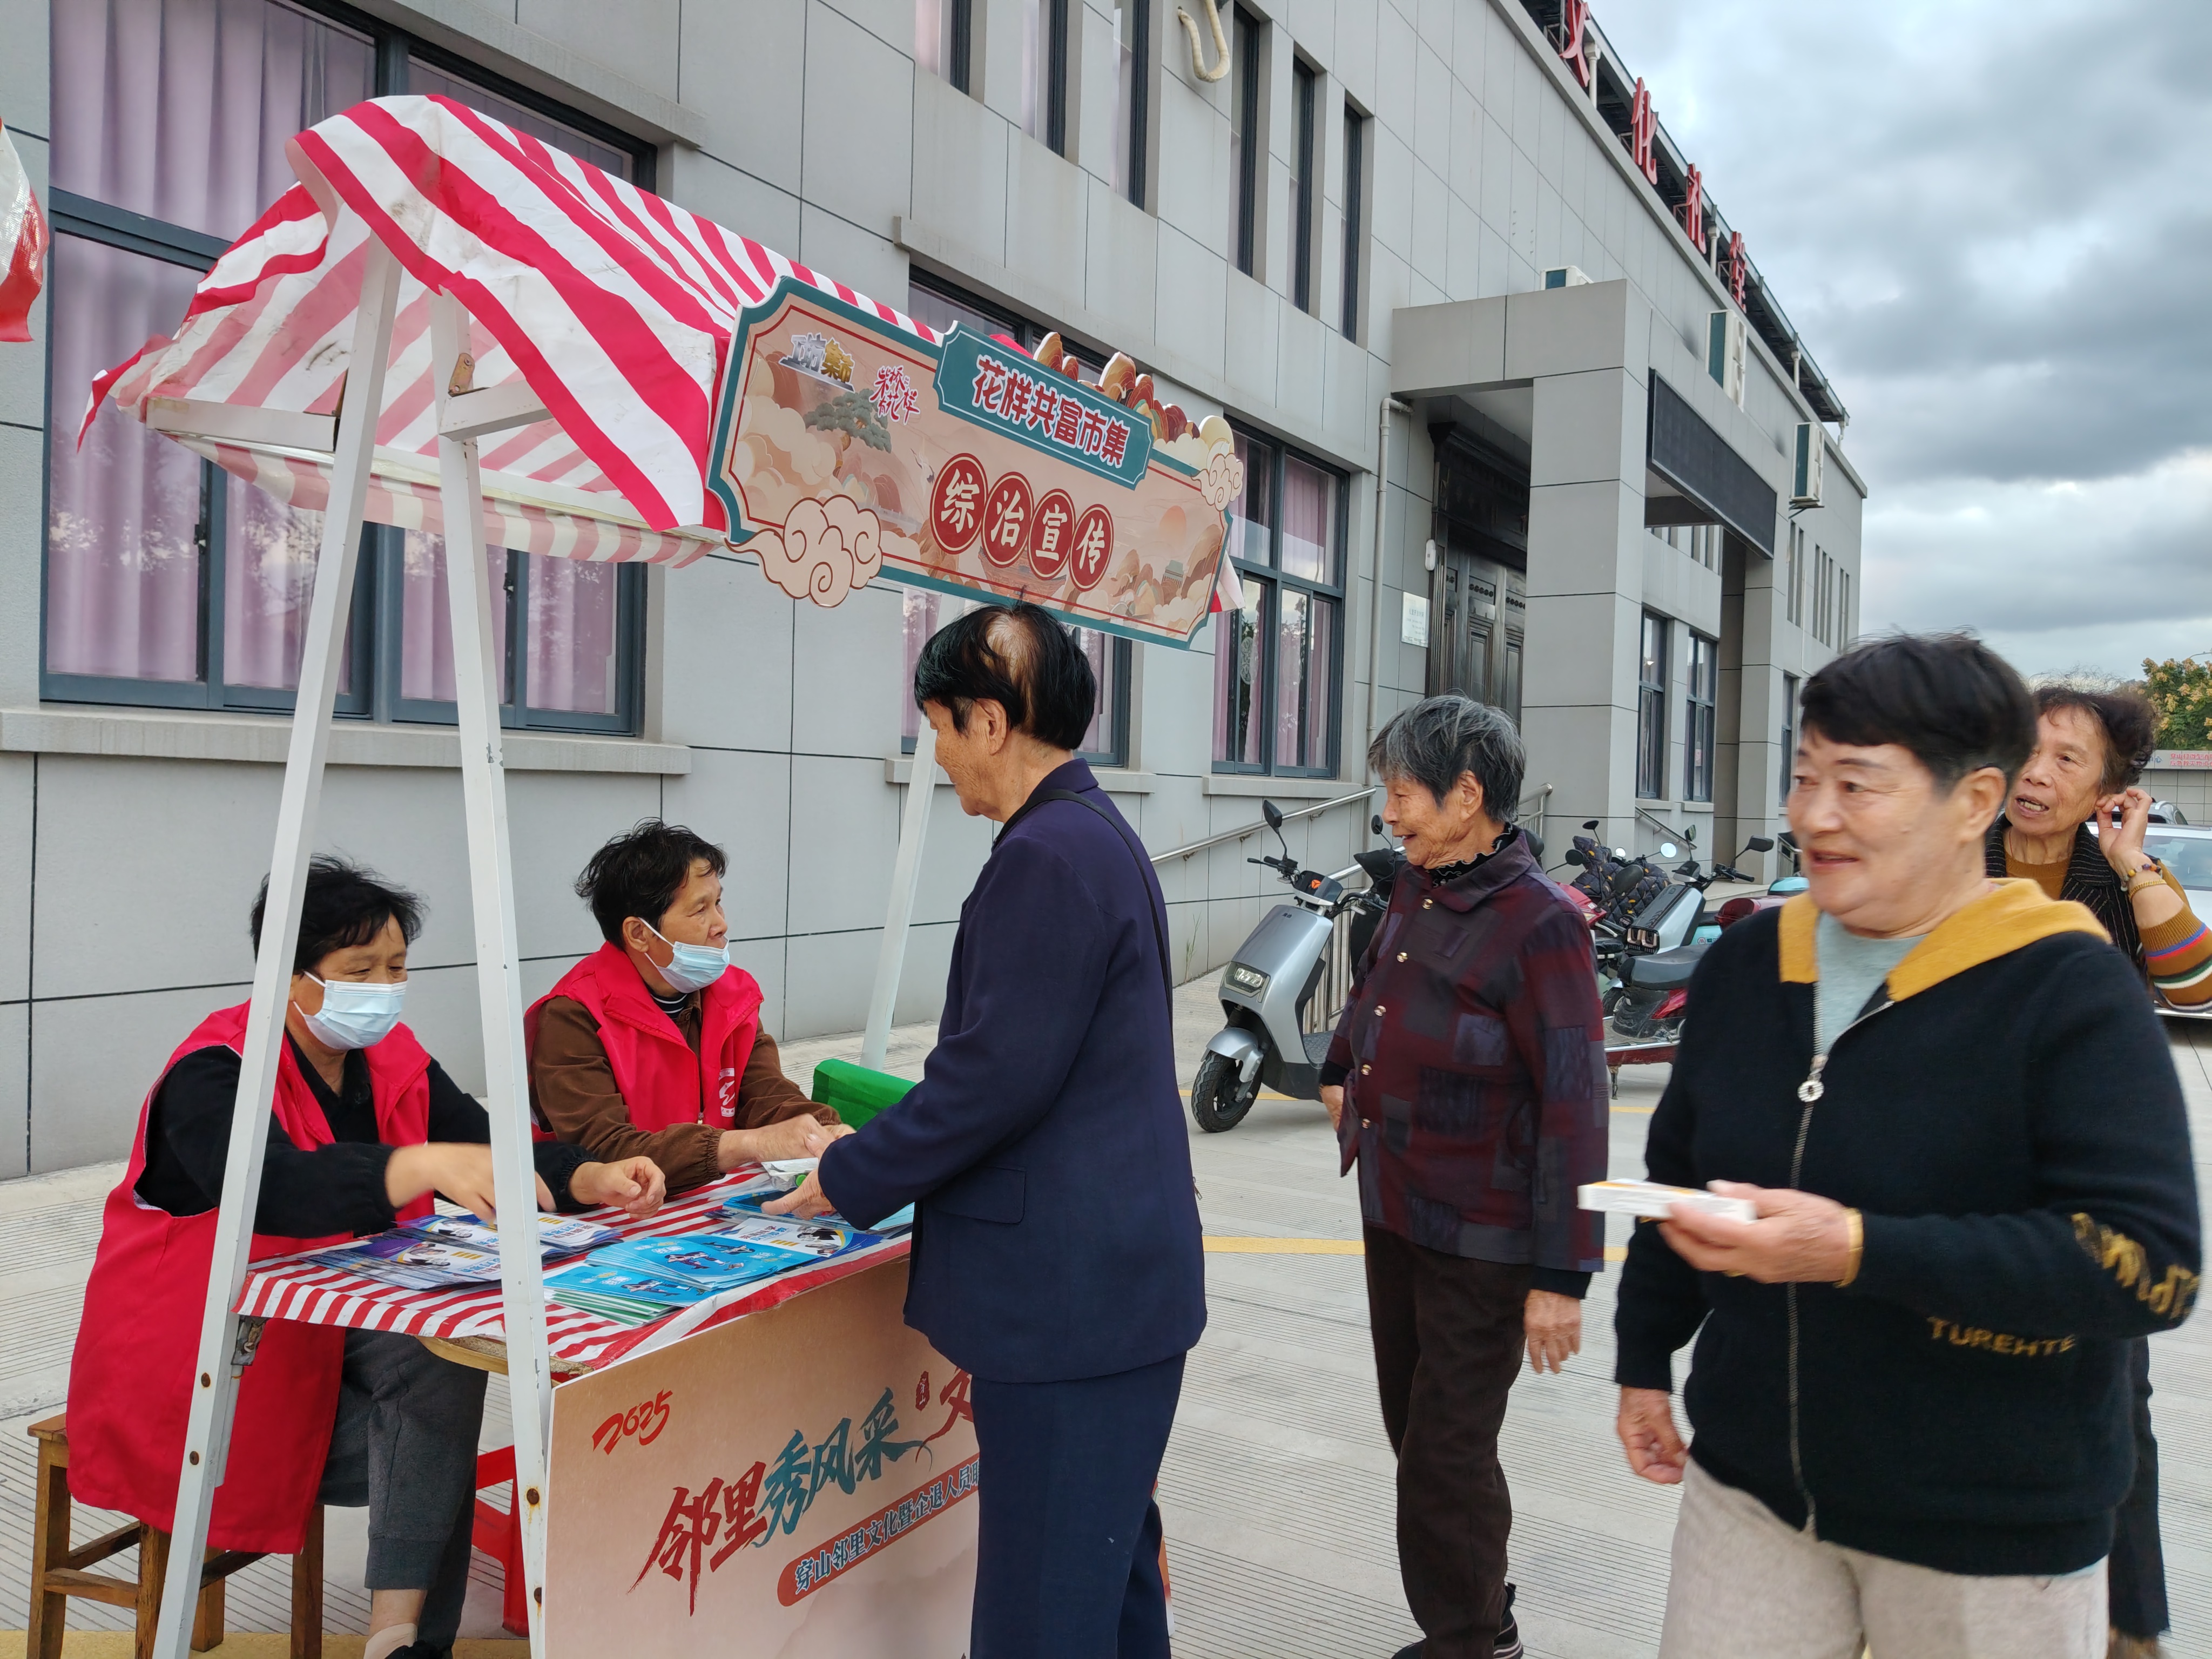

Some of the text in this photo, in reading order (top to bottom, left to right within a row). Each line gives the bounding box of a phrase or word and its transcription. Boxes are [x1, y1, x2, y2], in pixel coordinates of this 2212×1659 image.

[972, 354, 1131, 468] 花样共富市集
[940, 467, 1107, 567] 综治宣传
[593, 1388, 673, 1456] 2025
[626, 1387, 933, 1617] 邻里秀风采
